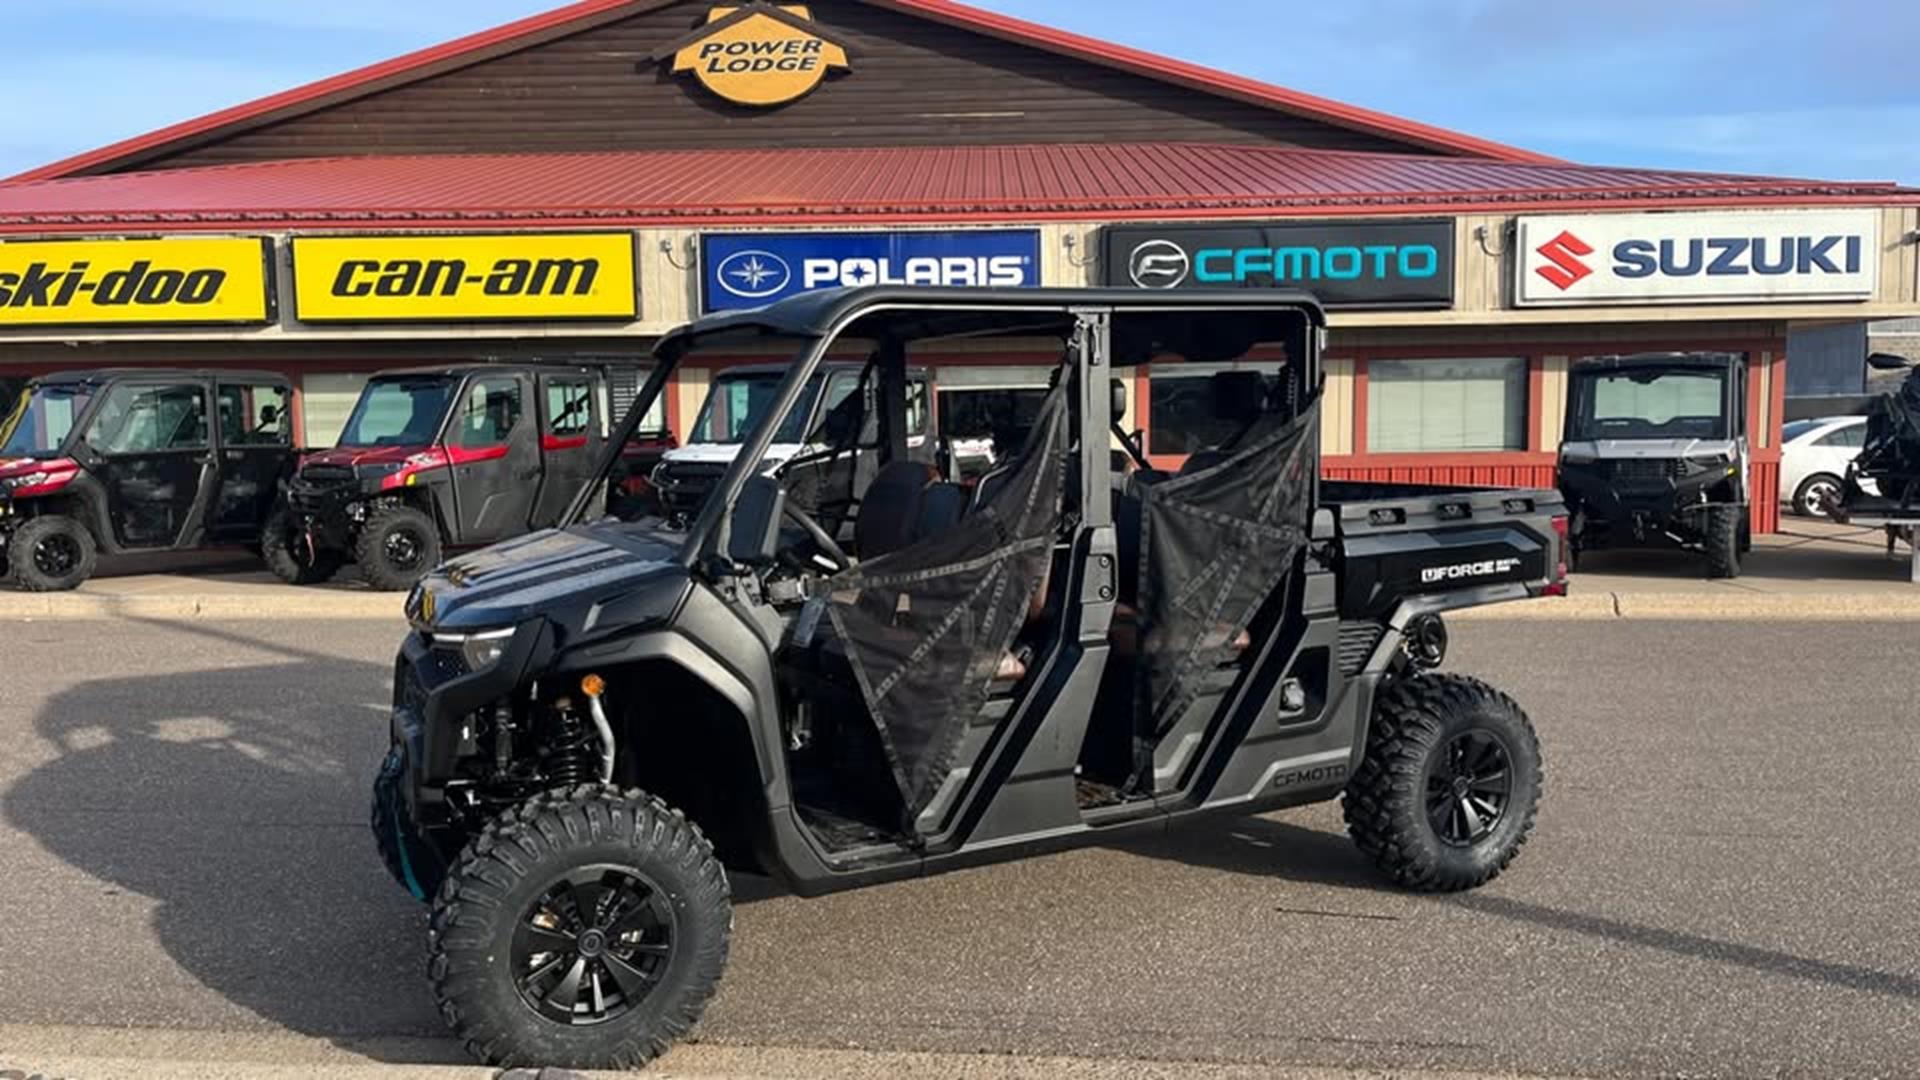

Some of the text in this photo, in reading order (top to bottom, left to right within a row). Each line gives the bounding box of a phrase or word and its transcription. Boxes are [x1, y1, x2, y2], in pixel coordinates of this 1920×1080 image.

[699, 39, 822, 59] POWER
[706, 56, 818, 73] LODGE
[803, 256, 1024, 288] POLARIS
[1195, 244, 1438, 281] CFMOTO
[1612, 235, 1861, 278] SUZUKI
[331, 258, 599, 297] can-am
